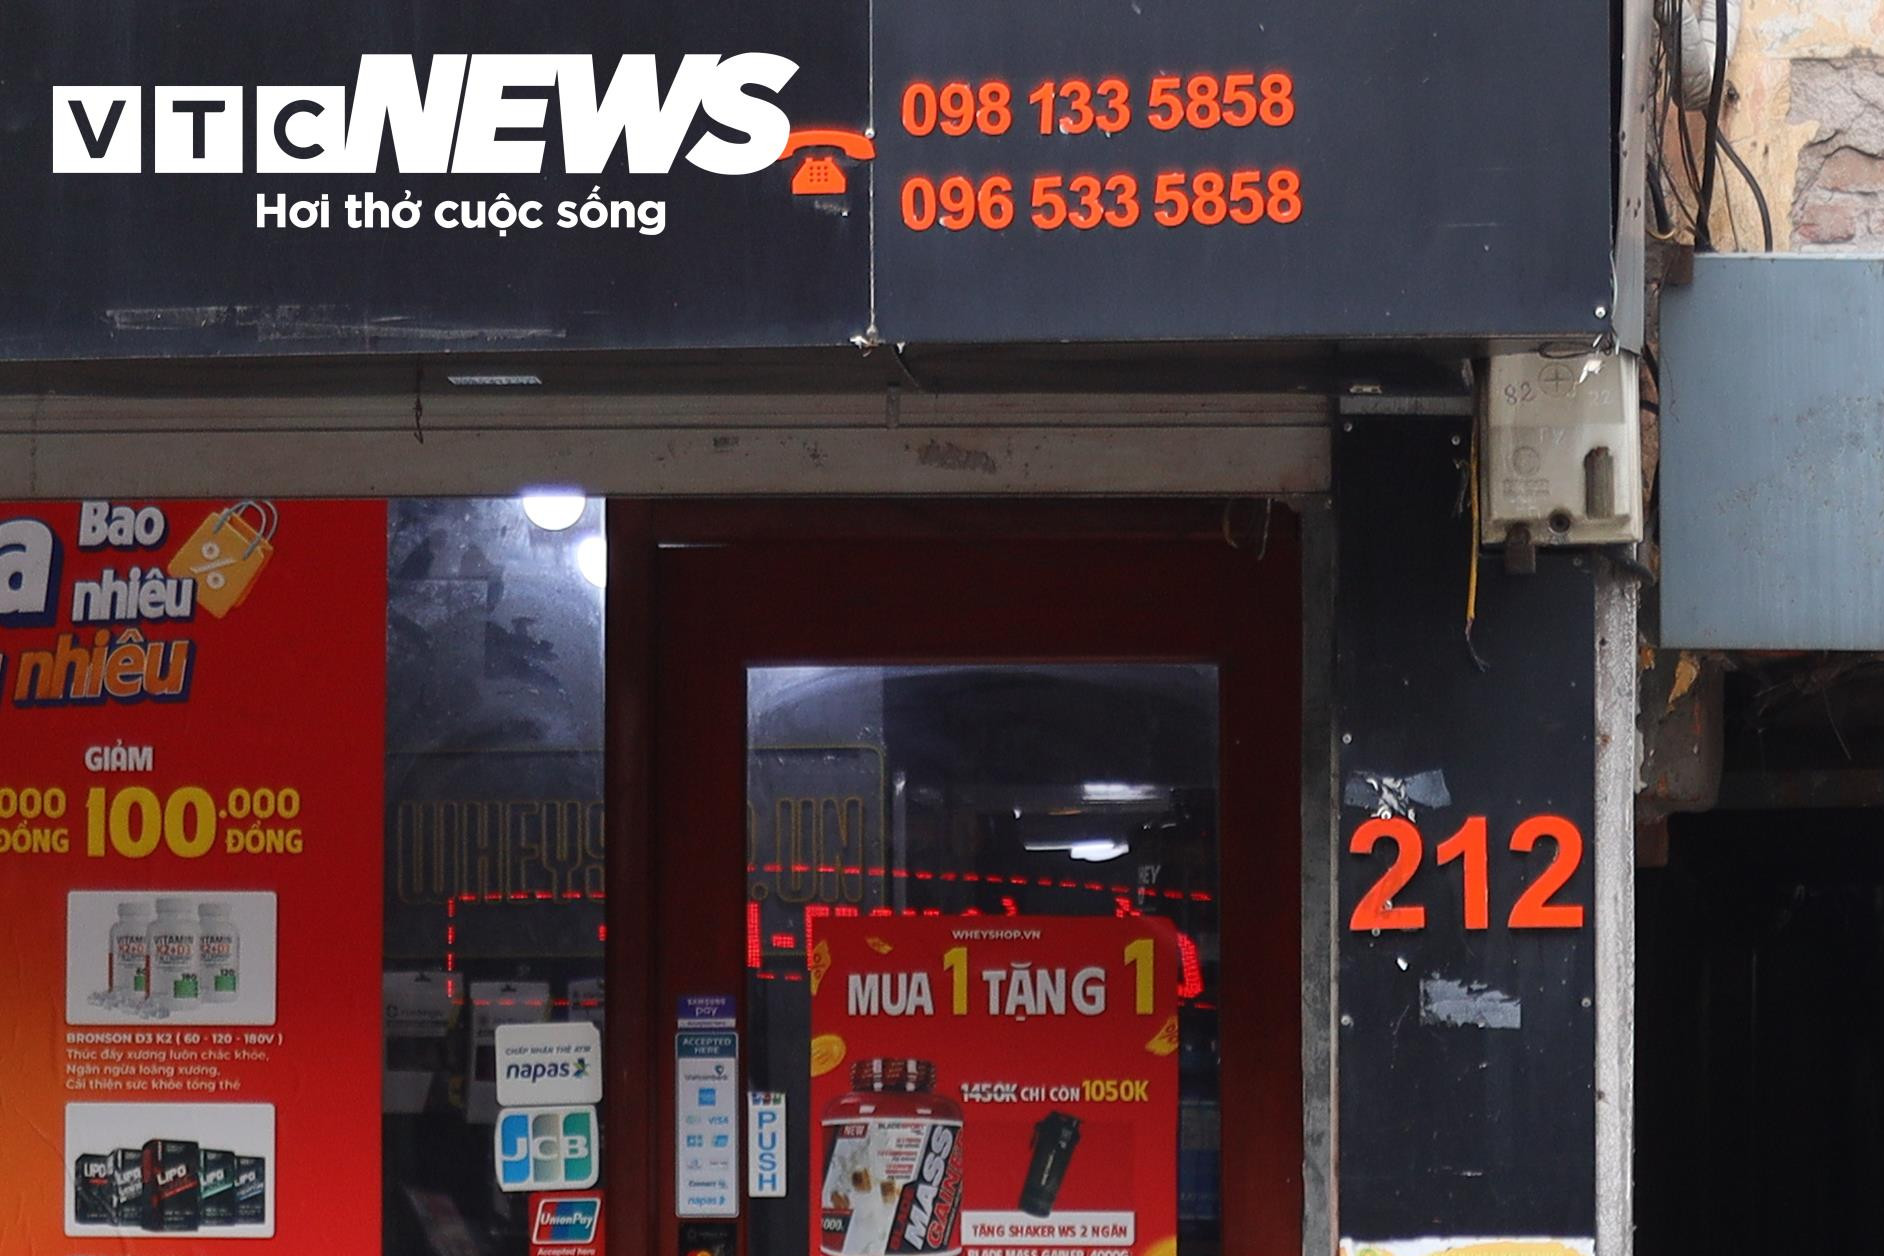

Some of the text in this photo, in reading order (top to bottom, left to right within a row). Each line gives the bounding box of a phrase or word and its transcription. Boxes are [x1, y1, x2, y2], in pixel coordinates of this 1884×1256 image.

[901, 73, 1295, 136] 098 133 5858
[902, 169, 1301, 231] 096 533 5858
[78, 500, 165, 547] Bao
[72, 567, 193, 622] nhiêu
[14, 628, 190, 701] nhiêu
[85, 739, 153, 773] GIẢM
[225, 820, 303, 855] ĐỒNG
[1349, 814, 1584, 931] 212
[952, 929, 1041, 940] WHEYSHOP.VN
[848, 939, 1155, 1021] MUA 1 TẶNG 1
[695, 1007, 719, 1016] pay
[66, 1033, 131, 1044] BRONSON
[135, 1033, 152, 1044] D3
[156, 1033, 172, 1045] K2
[184, 1033, 200, 1045] 60
[212, 1034, 232, 1045] 120
[683, 1038, 732, 1046] ACCEPTED
[695, 1047, 720, 1055] HERE
[506, 1062, 570, 1083] napas
[1082, 1080, 1149, 1102] 1050K
[758, 1111, 777, 1191] PUSH
[541, 1212, 593, 1229] UnionPay
[1009, 1225, 1055, 1238] SHAKER
[1058, 1225, 1077, 1237] WS
[1081, 1226, 1087, 1237] 2
